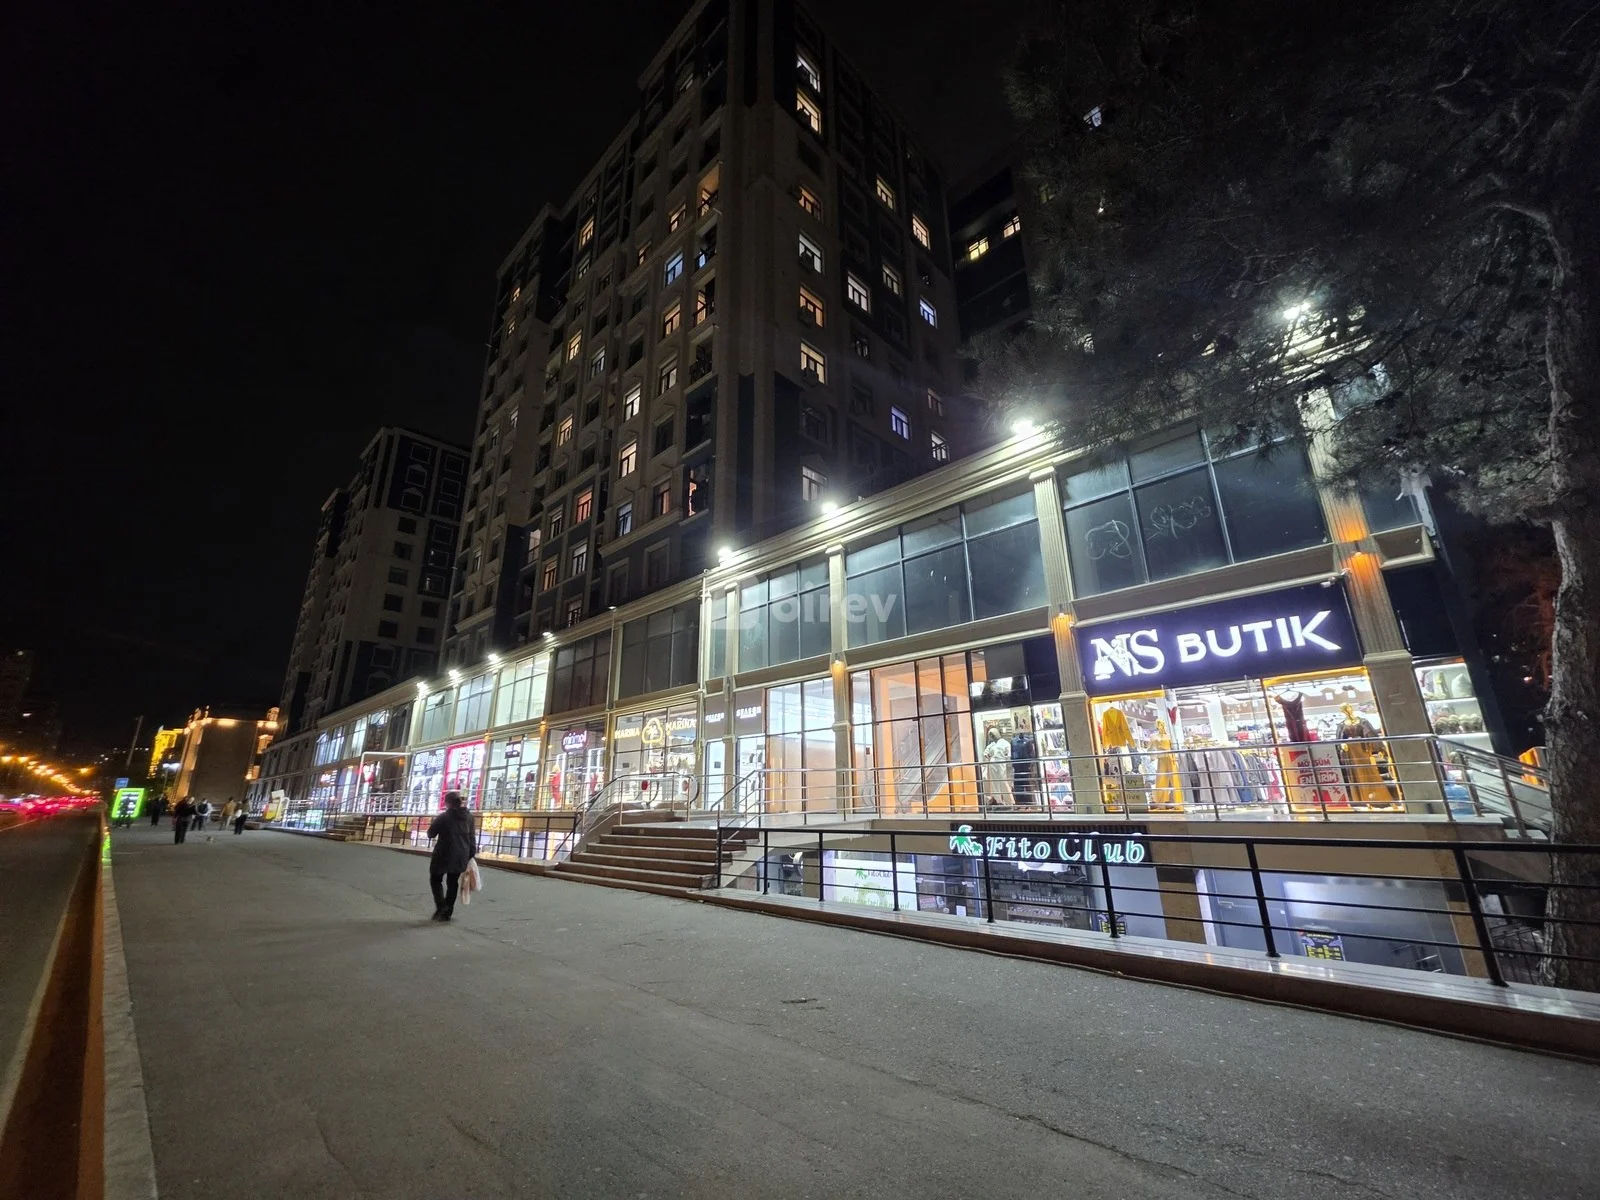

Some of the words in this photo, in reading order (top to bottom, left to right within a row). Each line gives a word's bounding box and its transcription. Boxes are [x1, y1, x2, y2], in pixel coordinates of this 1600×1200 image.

[1177, 610, 1342, 663] BUTIK
[986, 836, 1051, 860] Fito
[1058, 832, 1145, 863] Club
